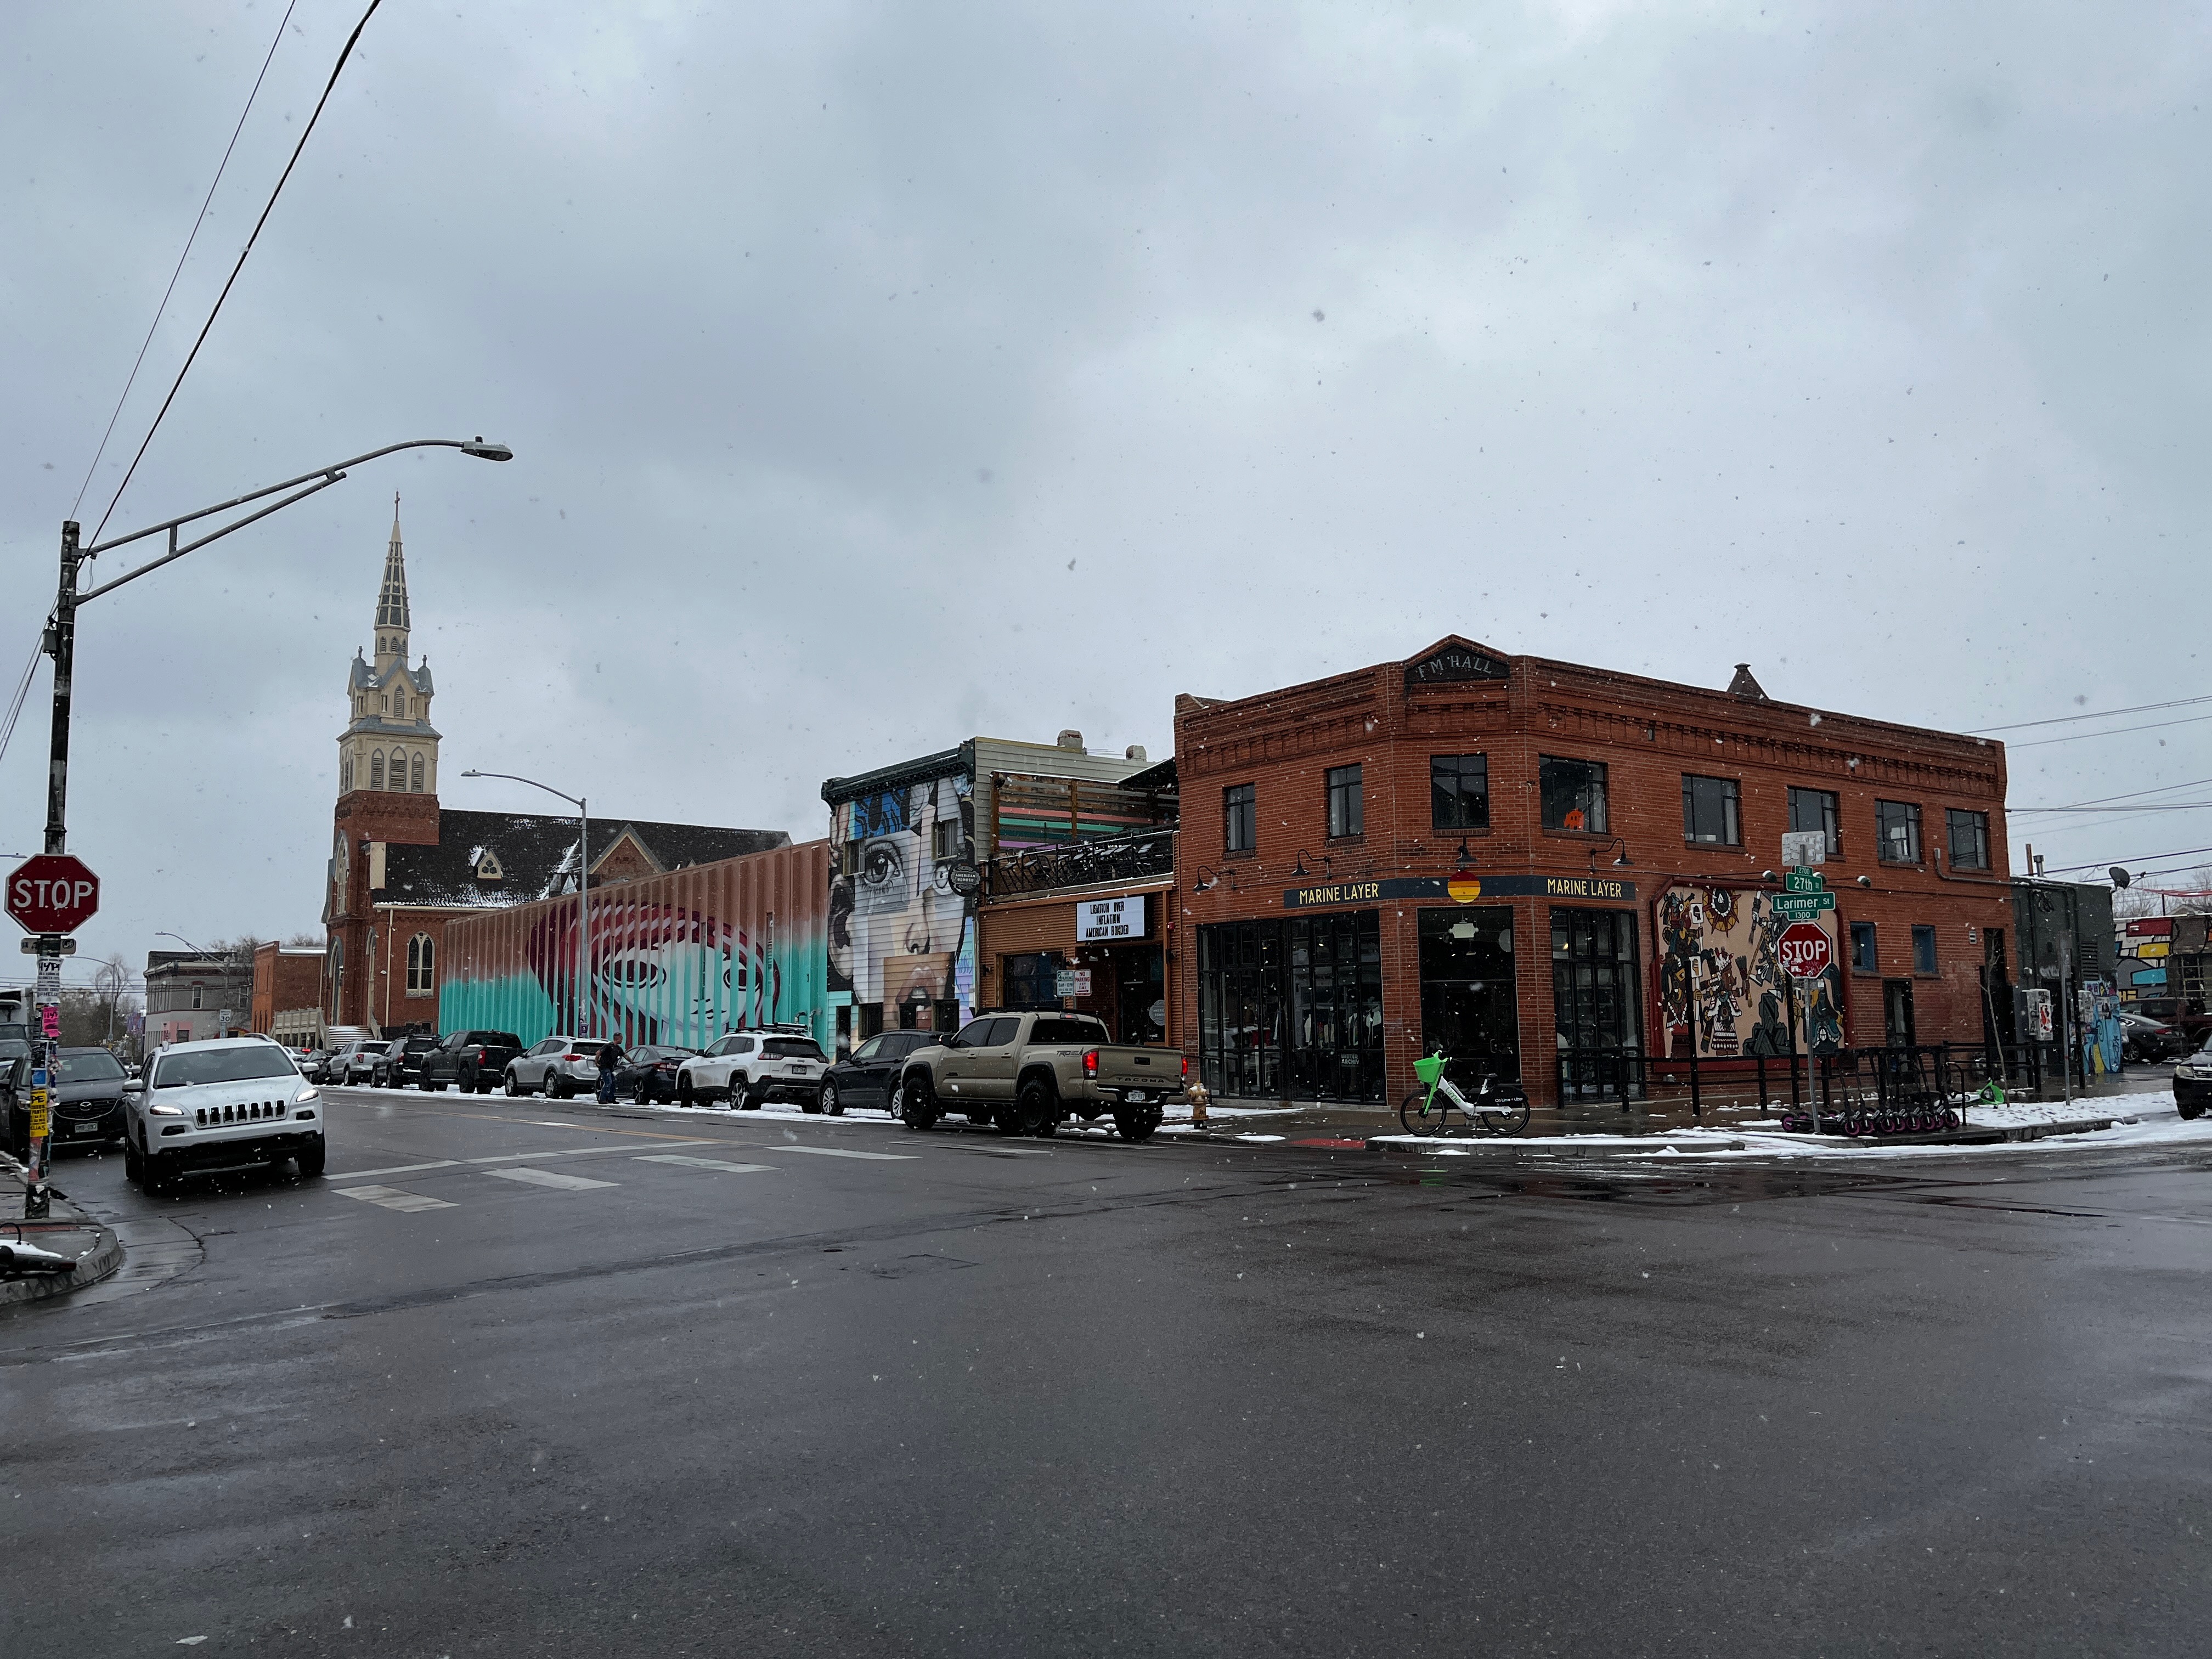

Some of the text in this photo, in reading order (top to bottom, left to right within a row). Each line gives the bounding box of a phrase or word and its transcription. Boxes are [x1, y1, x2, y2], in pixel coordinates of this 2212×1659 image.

[1450, 655, 1492, 674] HALL
[1547, 878, 1622, 898] MARINE LAYER
[1794, 877, 1813, 891] 27th
[13, 879, 93, 909] STOP
[1300, 883, 1379, 905] MARINE LAYER
[1090, 901, 1125, 915] LIBATION OVER
[1777, 897, 1818, 910] Larimer
[1096, 913, 1120, 926] INFLATION
[1086, 924, 1129, 938] AMERICAN BONDED
[1782, 940, 1826, 961] STOP
[1057, 972, 1062, 981] 2
[1445, 1086, 1461, 1104] Lime
